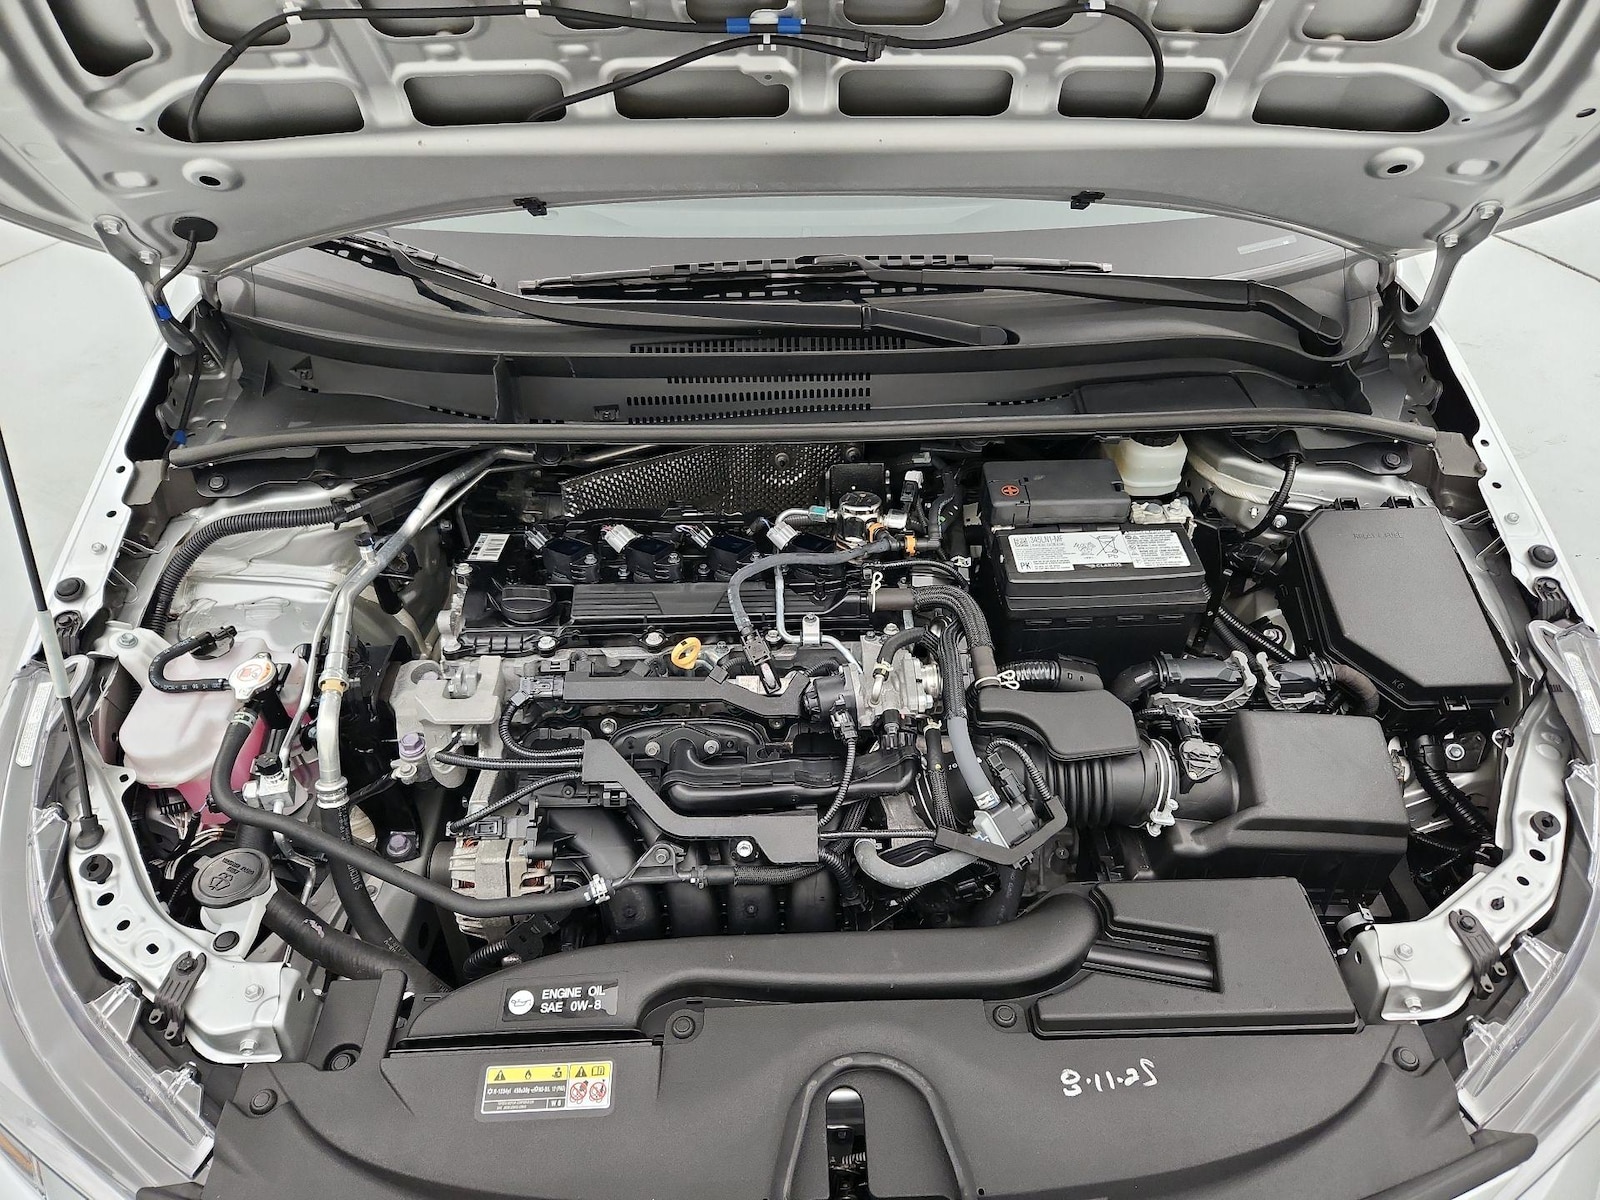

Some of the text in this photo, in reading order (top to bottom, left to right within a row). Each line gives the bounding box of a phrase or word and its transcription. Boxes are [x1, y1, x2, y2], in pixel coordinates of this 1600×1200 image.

[1020, 561, 1032, 570] PK
[541, 984, 606, 1000] ENGINE OIL
[539, 999, 602, 1014] SAE 0W-8
